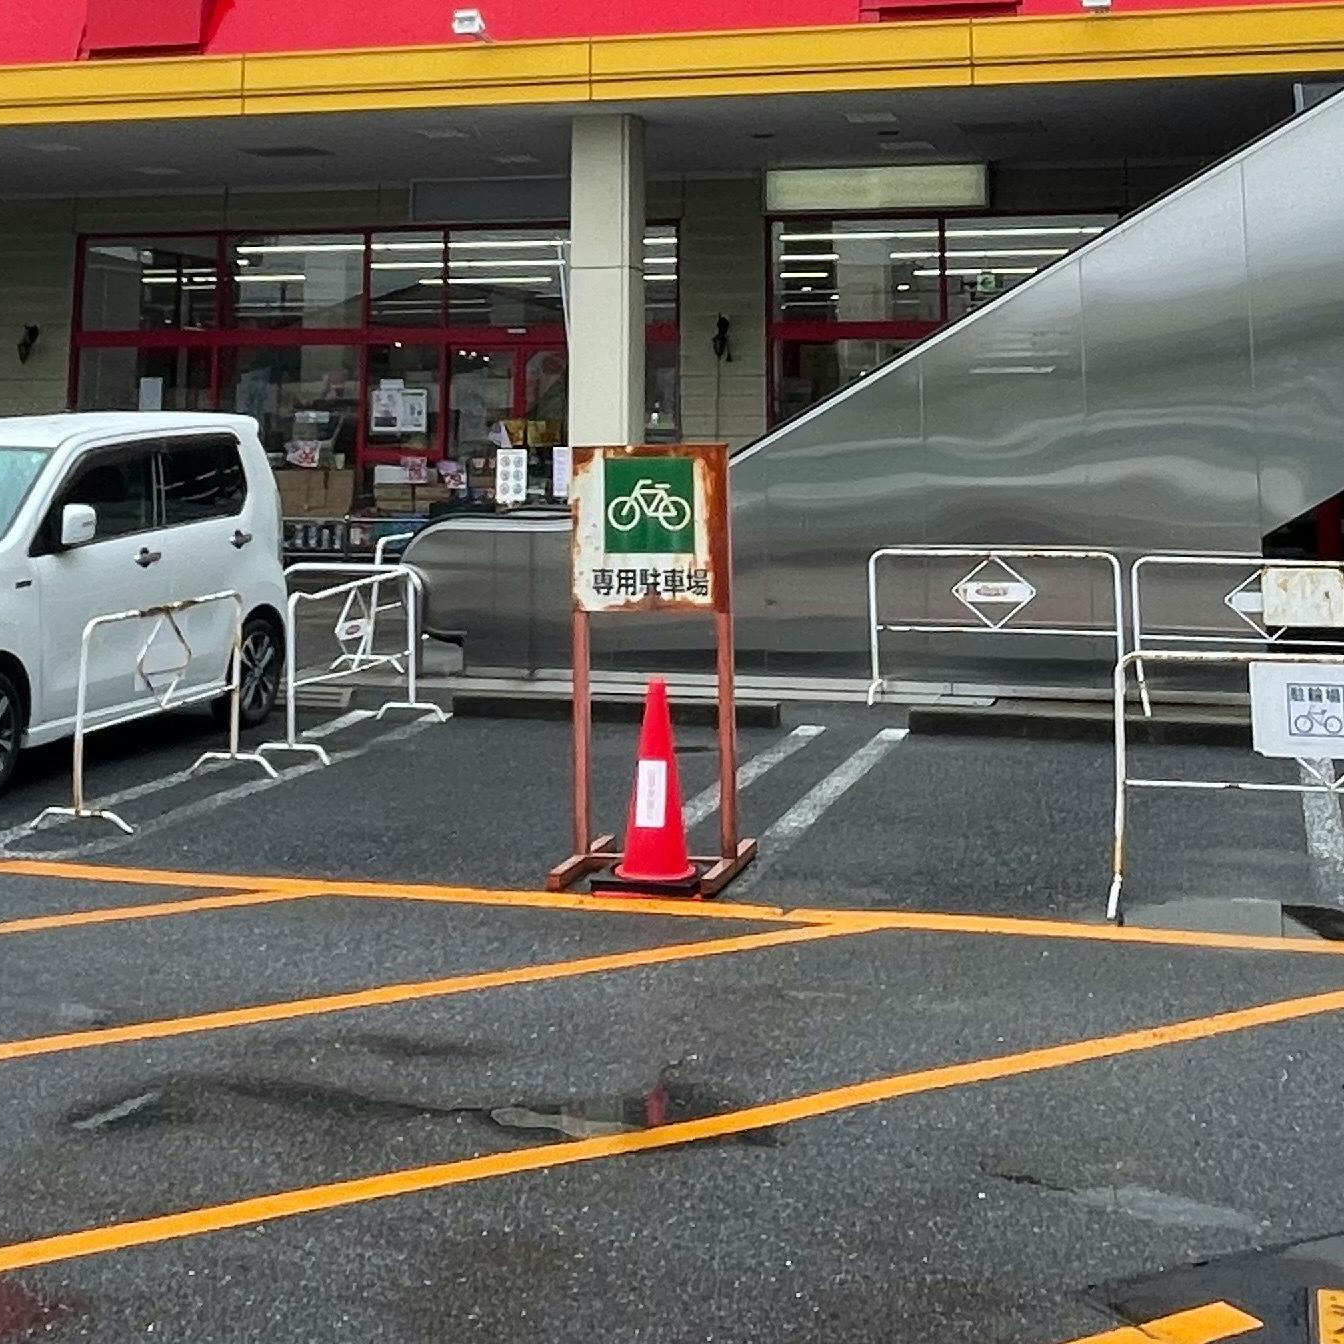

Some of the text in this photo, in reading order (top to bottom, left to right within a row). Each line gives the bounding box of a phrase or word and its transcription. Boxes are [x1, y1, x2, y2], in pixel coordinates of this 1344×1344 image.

[591, 567, 710, 597] 専用駐車場
